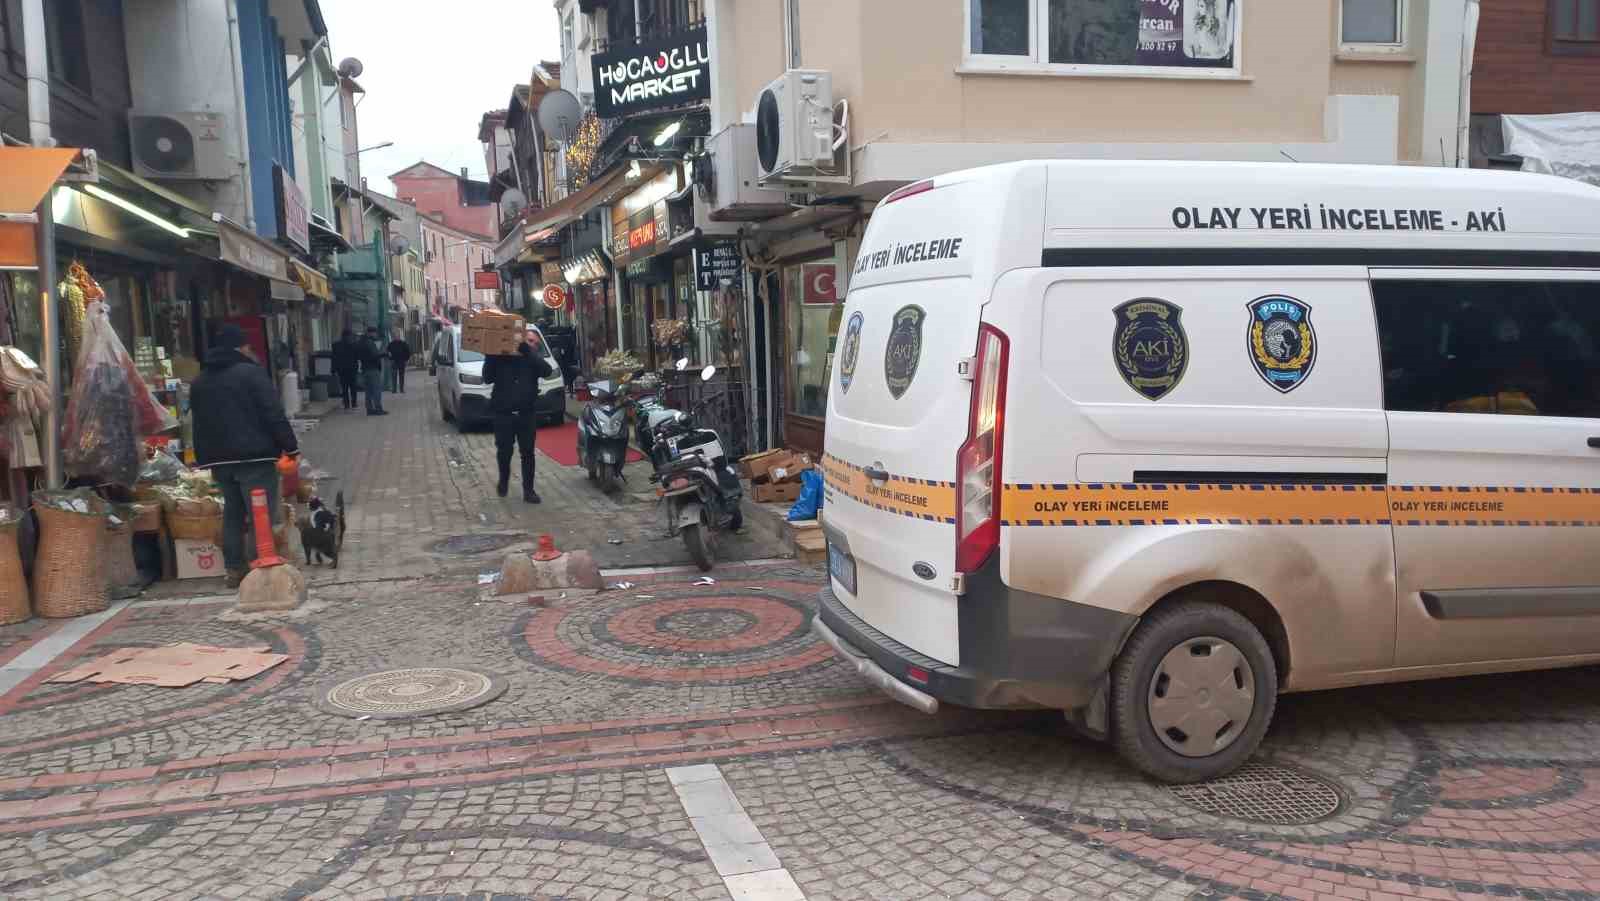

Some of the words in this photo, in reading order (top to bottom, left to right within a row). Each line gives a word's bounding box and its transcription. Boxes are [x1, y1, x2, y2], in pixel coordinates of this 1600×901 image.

[611, 69, 701, 105] MARKET
[1172, 206, 1242, 229] OLAY
[1250, 203, 1312, 229] YERİ
[1320, 203, 1445, 231] İNCELEME
[1466, 208, 1506, 231] AKİ
[893, 237, 963, 265] İNCELEME
[1034, 501, 1068, 512] OLAY
[1392, 501, 1420, 512] OLAY
